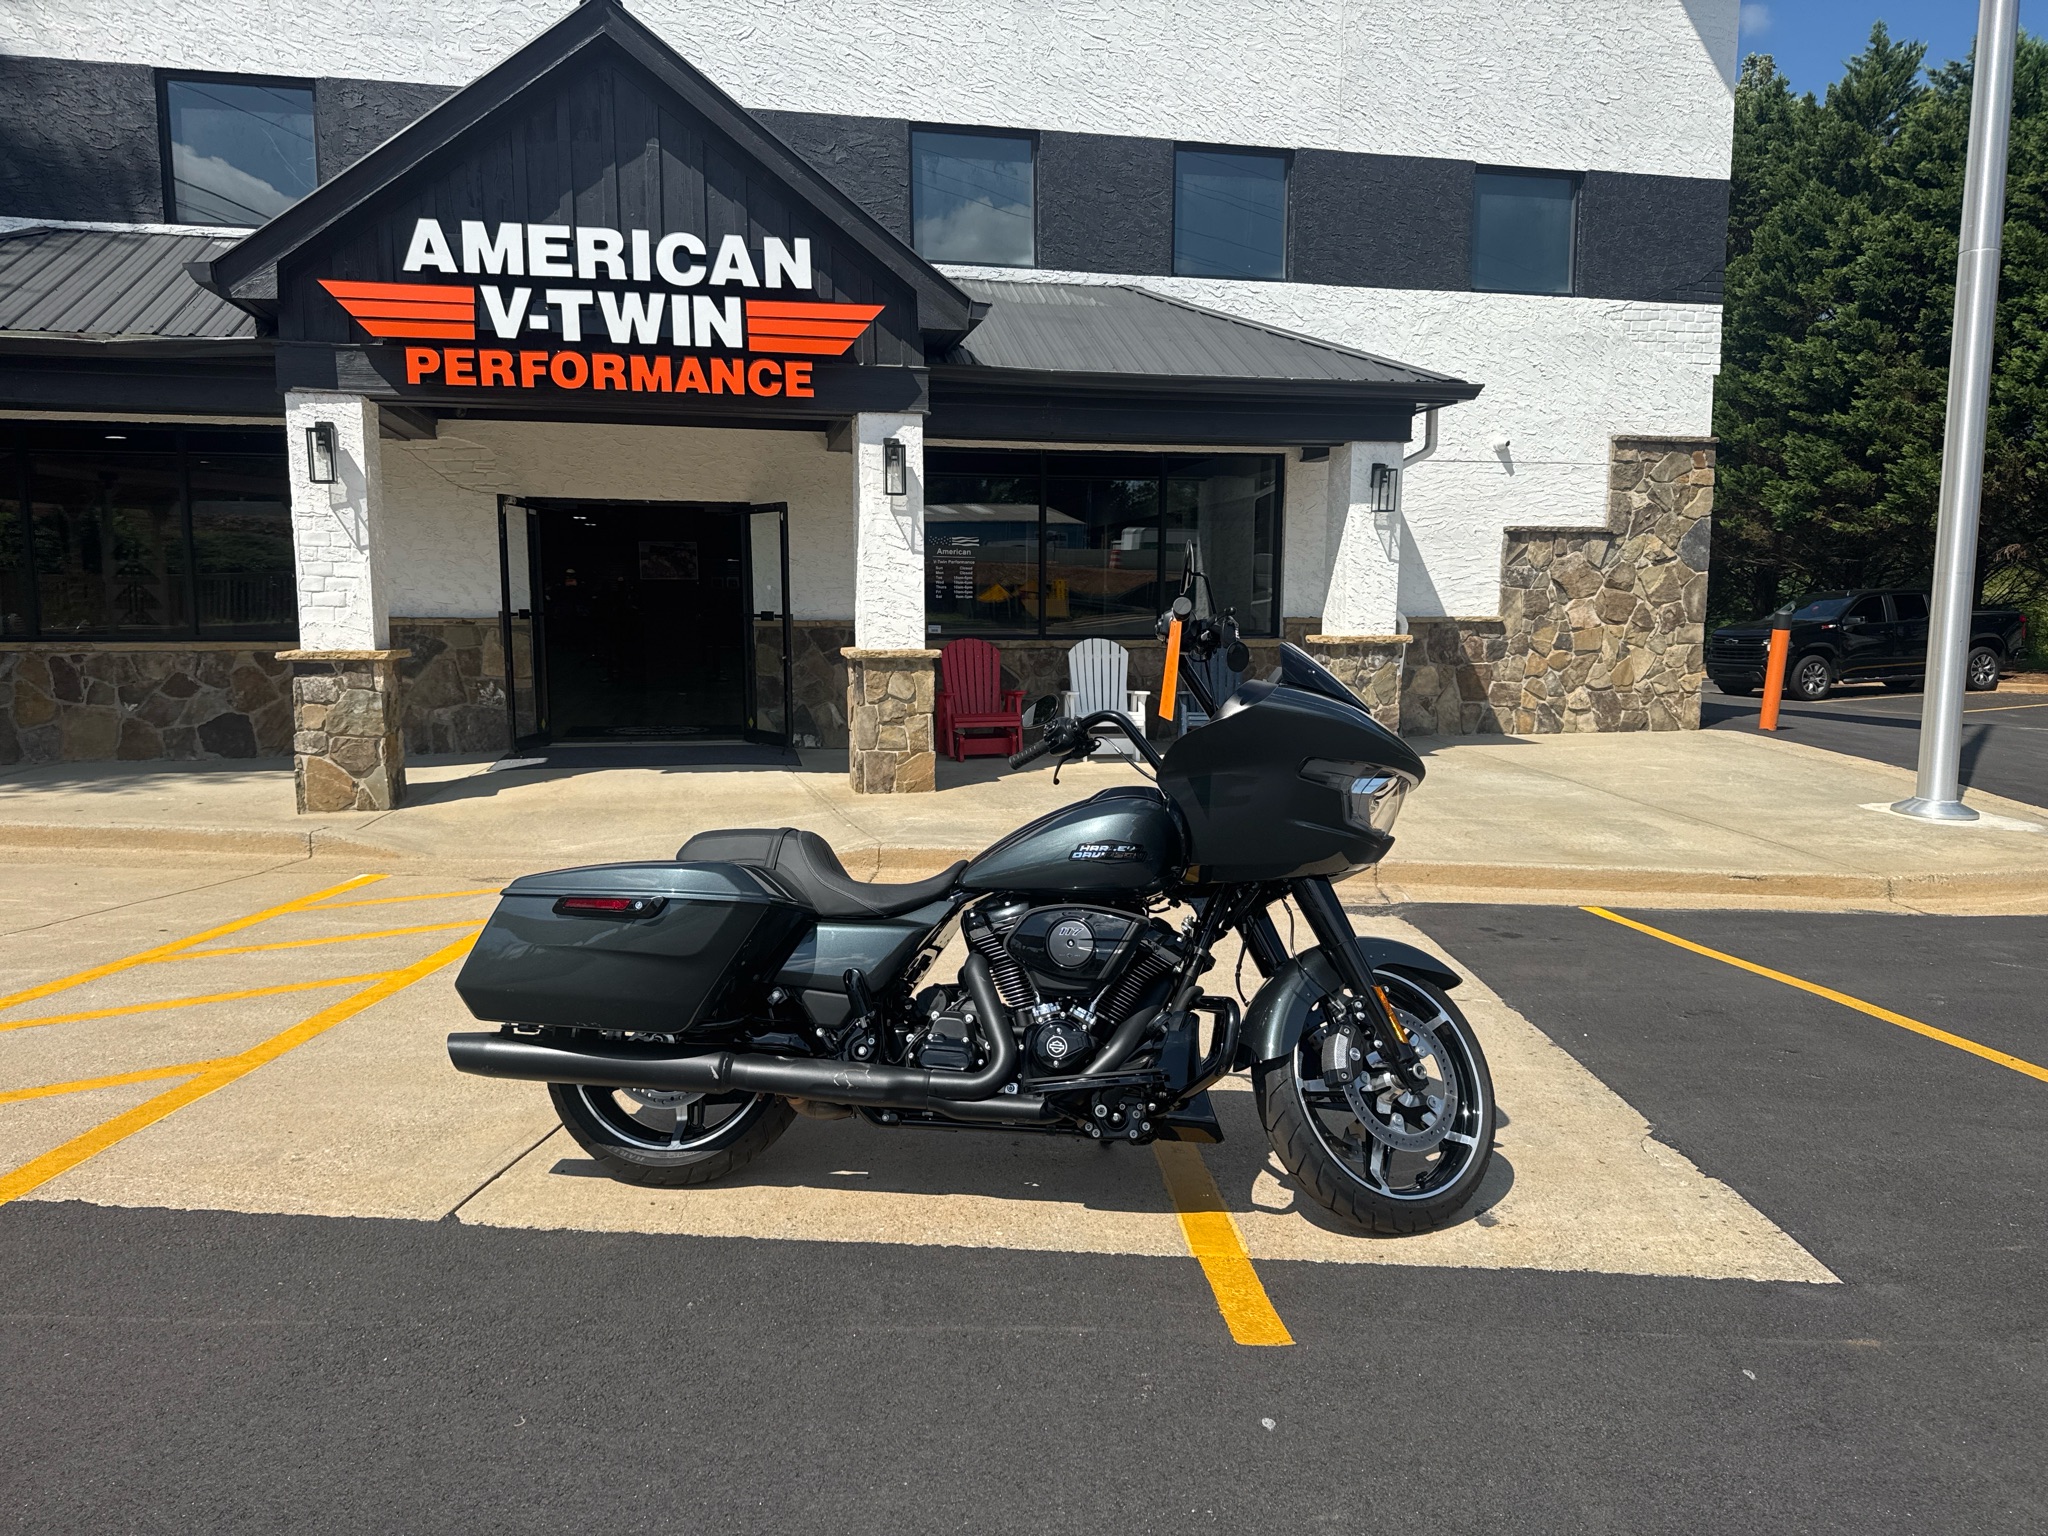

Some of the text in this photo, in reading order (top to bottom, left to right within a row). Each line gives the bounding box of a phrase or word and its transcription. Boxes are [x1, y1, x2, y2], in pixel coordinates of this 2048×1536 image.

[402, 217, 813, 290] AMERICAN
[481, 284, 745, 349] V-TWIN
[404, 346, 816, 398] PERFORMANCE
[1071, 851, 1143, 859] DAVISO
[1059, 927, 1084, 936] 117
